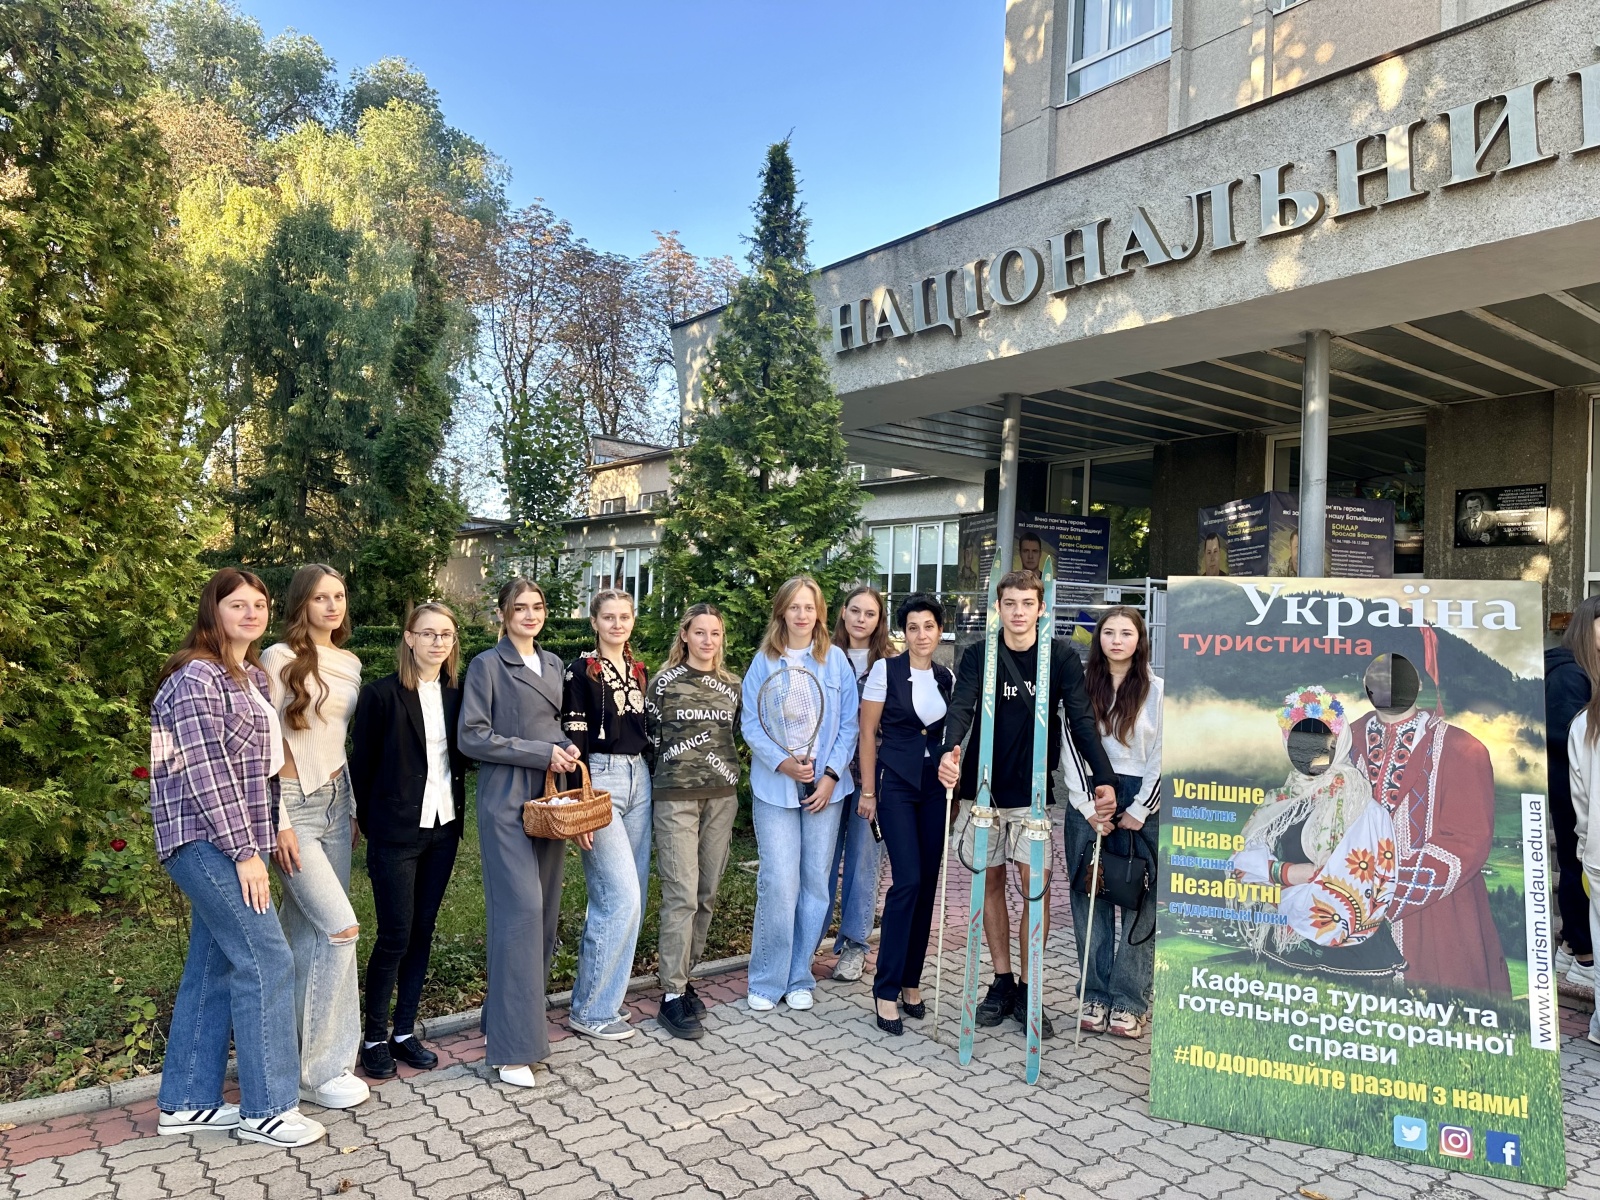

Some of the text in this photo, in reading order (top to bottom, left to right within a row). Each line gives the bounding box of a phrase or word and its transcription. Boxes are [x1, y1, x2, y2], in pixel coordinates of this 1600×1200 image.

[1331, 523, 1359, 531] БОНДАР
[1346, 514, 1384, 523] Батьківщину!
[1357, 532, 1388, 540] Борисович
[1237, 582, 1522, 639] Україна
[1178, 633, 1373, 657] туристична
[701, 675, 738, 706] ROMAN
[1003, 681, 1018, 700] he
[676, 709, 733, 722] ROMANCE
[663, 731, 711, 763] ROMANCE
[1172, 778, 1265, 805] Успішне
[1171, 805, 1237, 823] майбутнє
[1171, 825, 1246, 852] Цікаве
[1170, 854, 1236, 871] навчання
[1170, 872, 1282, 904] Незабутні
[1253, 912, 1289, 926] роки
[1527, 800, 1552, 1043] www.tourism.udau.edu.ua
[1190, 966, 1499, 1029] Кафедра туризму та
[1178, 992, 1517, 1056] готельно-ресторанної
[1288, 1033, 1398, 1067] справи
[1173, 1044, 1530, 1119] #Подорожуйте разом з нами!
